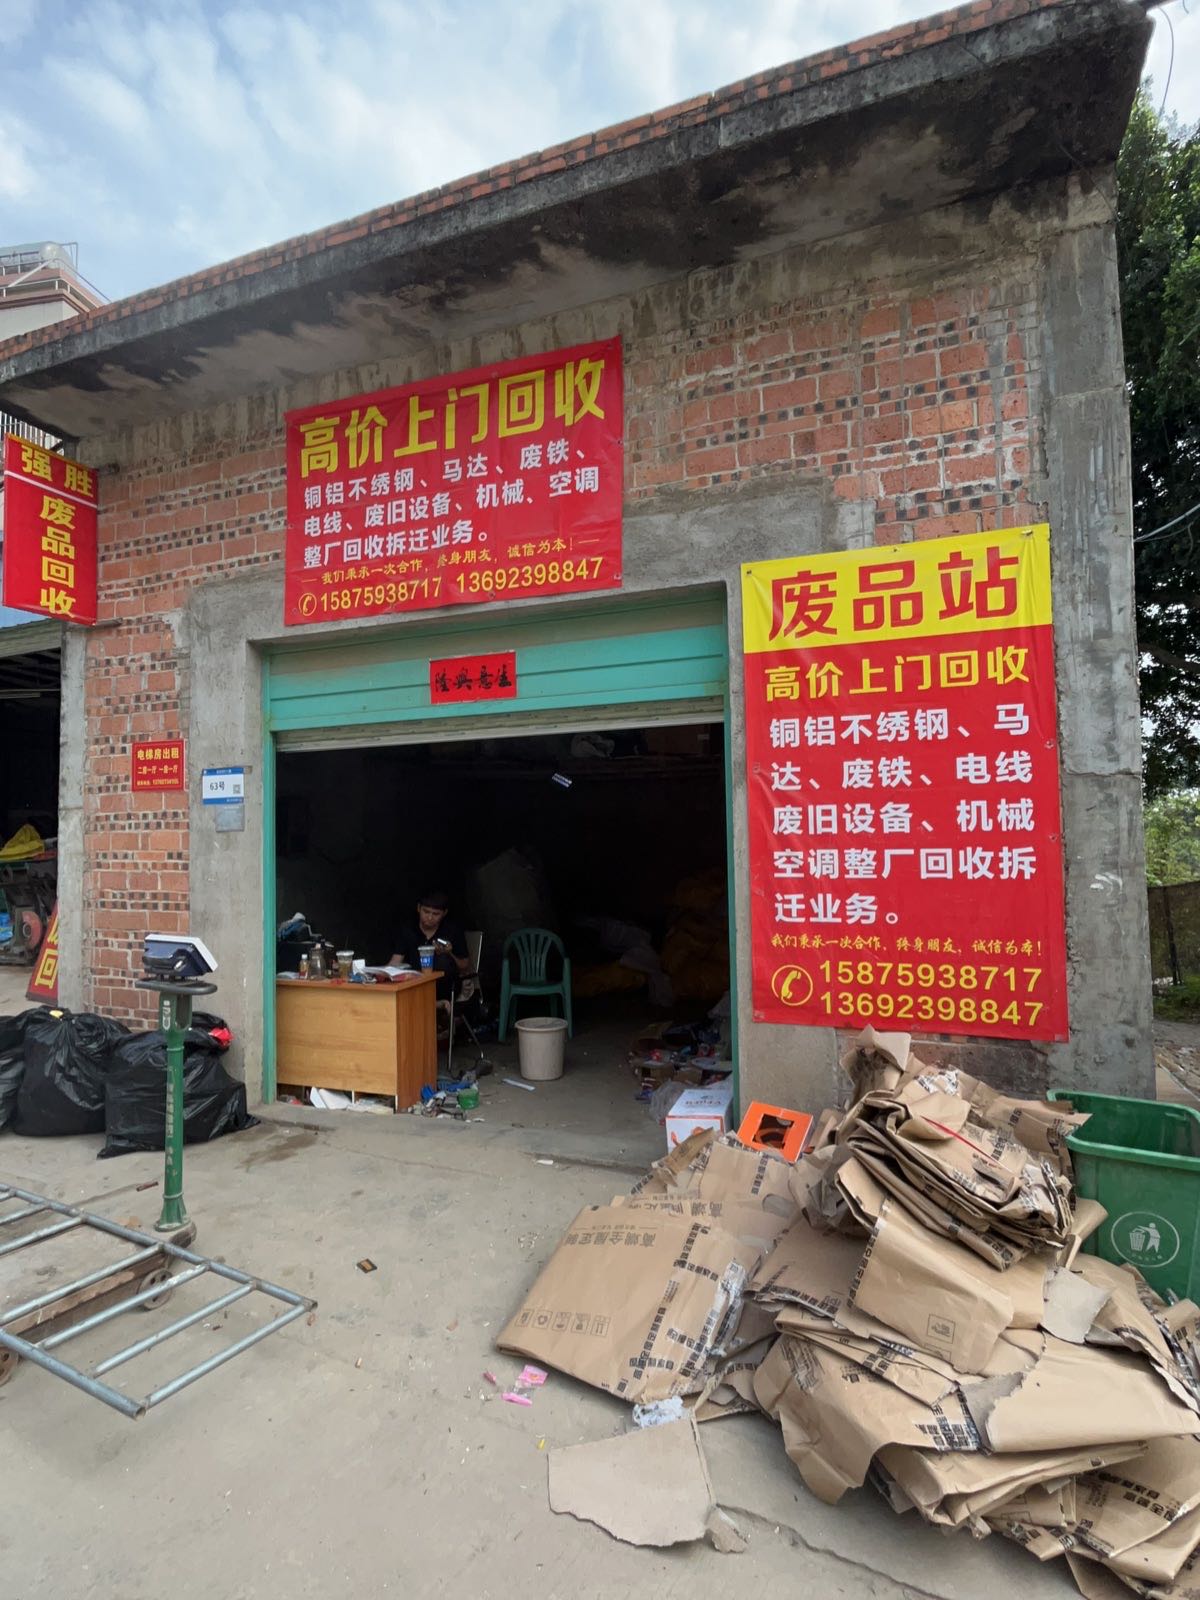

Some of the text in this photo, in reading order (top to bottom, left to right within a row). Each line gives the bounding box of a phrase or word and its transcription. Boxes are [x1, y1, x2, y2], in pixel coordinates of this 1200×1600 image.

[300, 358, 605, 477] 高价上门回收
[22, 444, 95, 498] 强胜
[40, 495, 77, 618] 废品回收
[303, 519, 488, 569] 整厂回收拆迁业务。
[320, 557, 603, 613] 15875938717 13692398847
[768, 546, 1019, 642] 废品站
[765, 645, 1030, 701] 高价上门回收
[137, 747, 179, 761] 电梯房出租
[209, 781, 225, 791] 63号
[772, 798, 1035, 835] 废旧设备、机械
[773, 846, 1037, 880] 空调整厂回收拆
[775, 892, 898, 925] 迁业务。
[820, 960, 1042, 993] 15875938717
[820, 992, 1044, 1027] 13692398847
